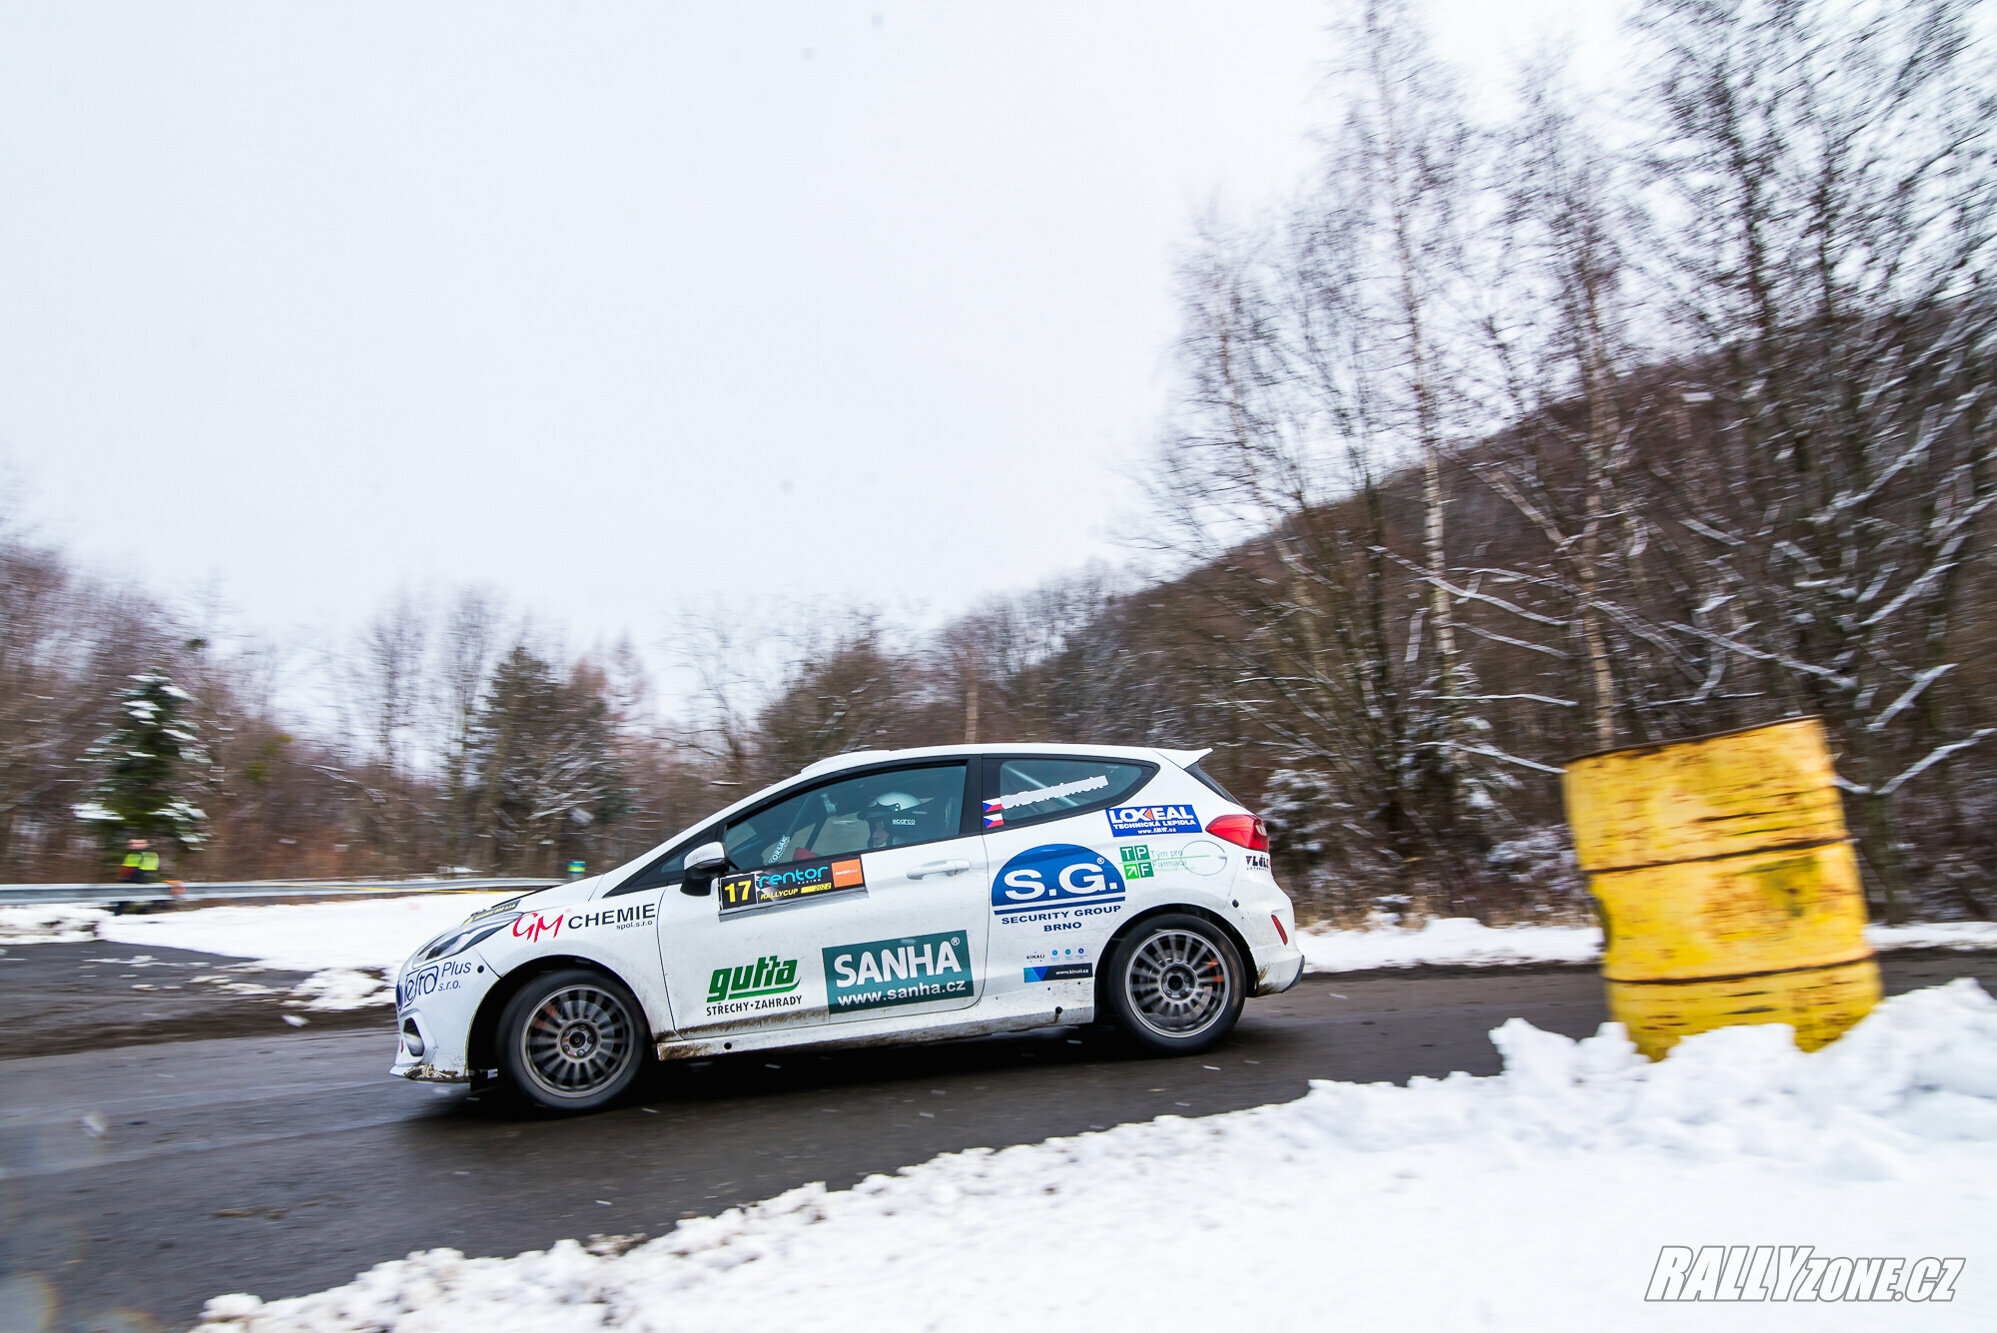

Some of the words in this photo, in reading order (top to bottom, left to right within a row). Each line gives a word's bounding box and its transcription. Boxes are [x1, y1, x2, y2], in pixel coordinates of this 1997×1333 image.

[1108, 806, 1194, 824] LOXEAL
[1113, 820, 1161, 830] TECHNICKÁ
[1162, 819, 1197, 827] LEPIDLA
[1150, 850, 1168, 861] Tým
[758, 866, 828, 888] rentor
[1003, 863, 1118, 901] S.G.
[725, 880, 751, 903] 17
[760, 888, 798, 900] RALLYCUP
[512, 912, 564, 943] GM
[567, 903, 656, 930] CHEMIE
[1002, 911, 1069, 925] SECURITY
[1074, 905, 1122, 917] GROUP
[1043, 922, 1082, 932] BRNO
[441, 961, 472, 977] Plus
[833, 940, 962, 988] SANHA
[437, 980, 461, 992] s.r.o.
[706, 955, 799, 1004] gutta
[837, 980, 966, 1007] www.sanha.cz
